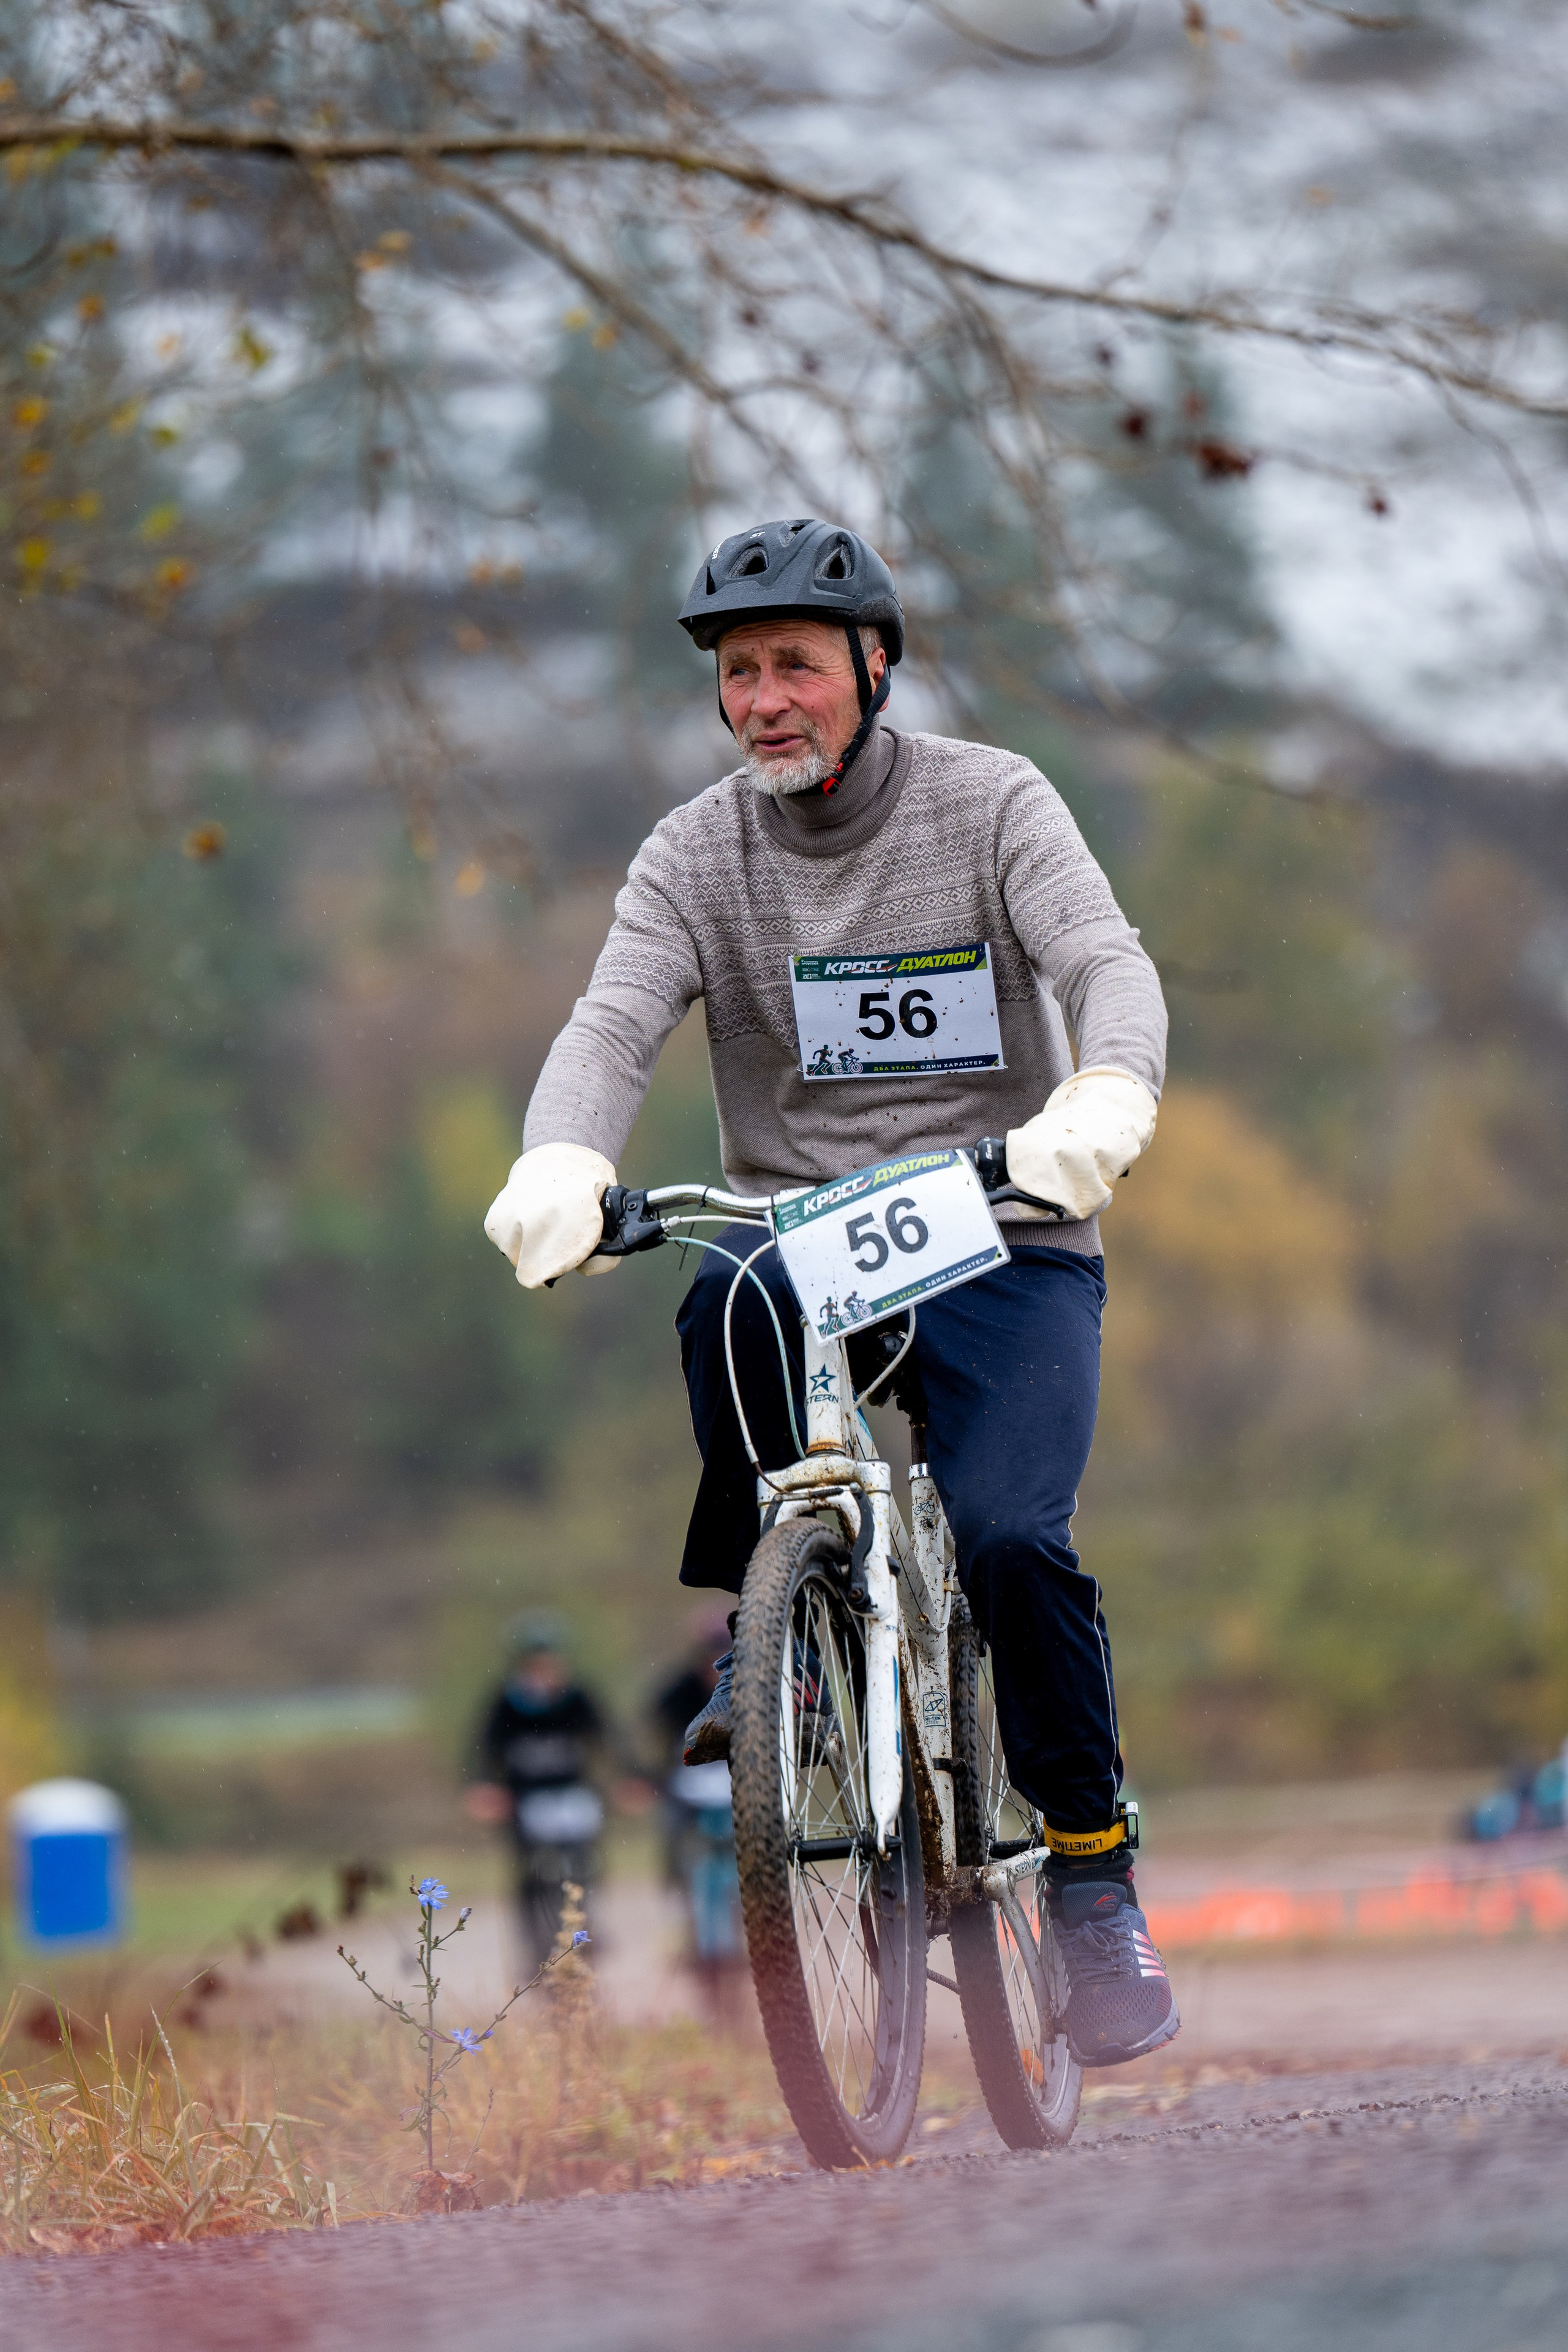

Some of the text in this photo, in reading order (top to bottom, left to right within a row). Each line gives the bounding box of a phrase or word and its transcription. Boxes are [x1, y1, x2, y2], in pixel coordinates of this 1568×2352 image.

[824, 951, 976, 975] КРОСС ДУАТЛОН
[858, 989, 938, 1041] 56
[804, 1154, 949, 1216] КРОСС ДУАТЛОН
[845, 1197, 929, 1272] 56
[882, 1257, 988, 1308] ДВА ЭТАПА. ОДИН ХАРАКТЕР.
[806, 1394, 839, 1408] STERN
[1052, 1837, 1102, 1852] LIMETIME
